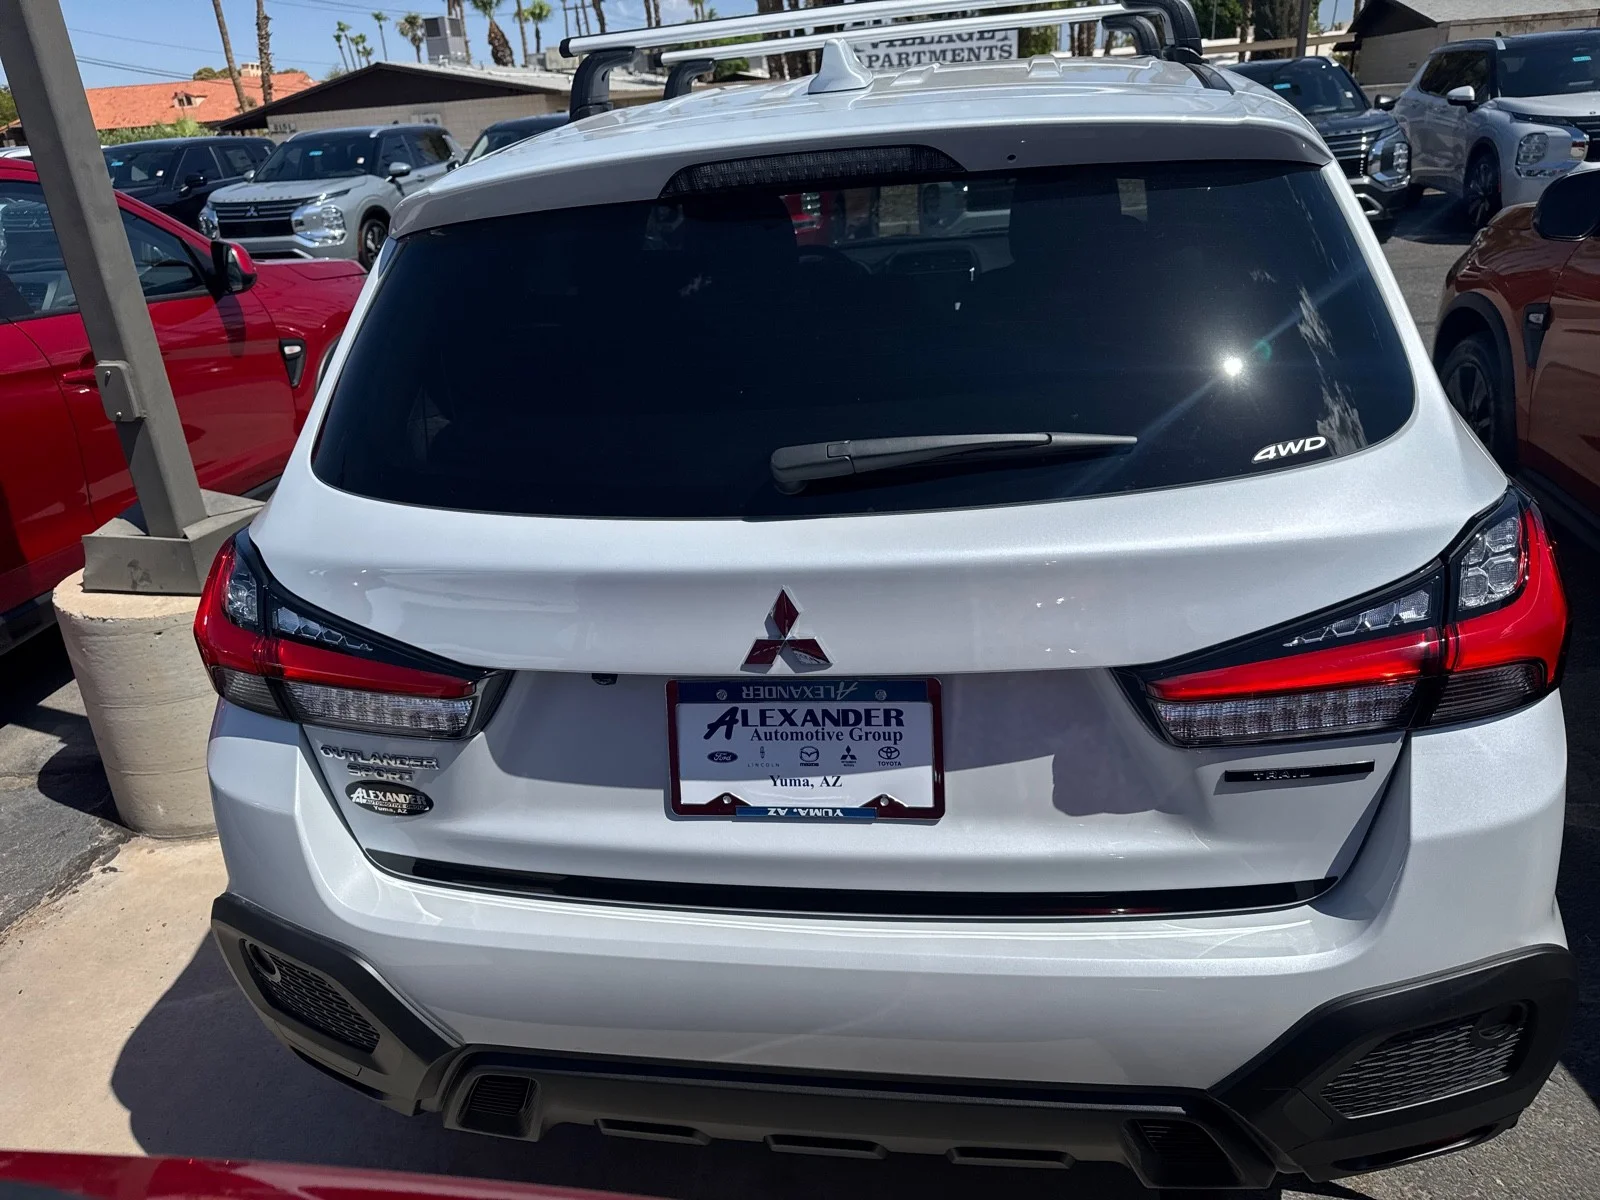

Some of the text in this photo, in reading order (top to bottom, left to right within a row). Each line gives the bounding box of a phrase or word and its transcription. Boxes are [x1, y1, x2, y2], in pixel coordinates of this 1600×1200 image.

[871, 30, 995, 48] LLAGE
[857, 44, 1012, 68] PARTMENTS
[1253, 436, 1327, 461] 4WD
[742, 682, 858, 700] ALEXANDER
[704, 707, 905, 740] ALEXANDER
[750, 728, 903, 745] Automotive Group
[320, 744, 440, 770] OUTLANDER
[711, 752, 734, 762] Ford
[347, 763, 413, 782] SPORT
[1253, 770, 1311, 780] TRAIL
[769, 775, 843, 789] Yuma, AZ
[350, 788, 427, 806] ALEXANDER
[767, 807, 844, 818] YUMA, AZ
